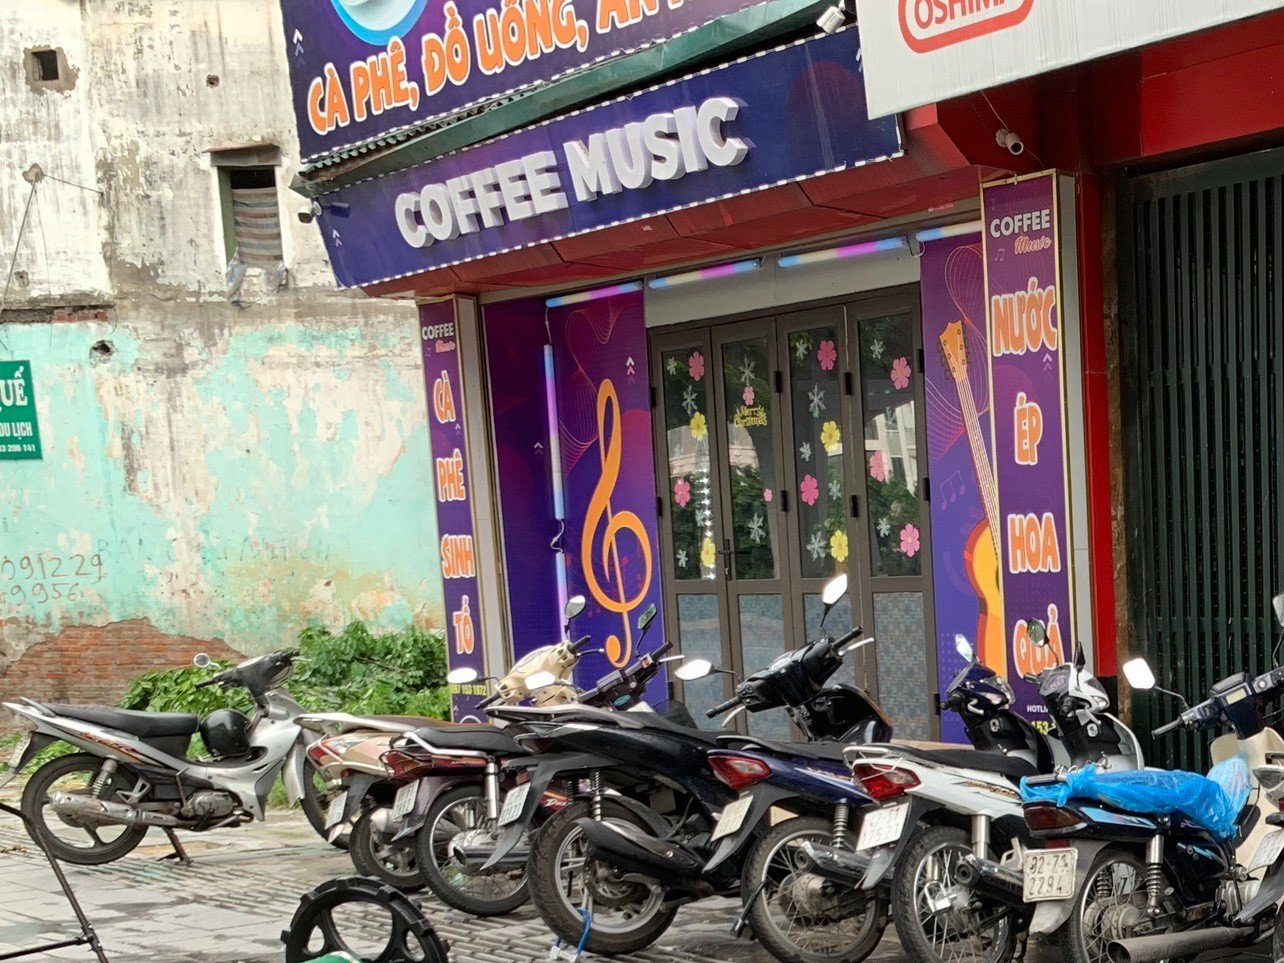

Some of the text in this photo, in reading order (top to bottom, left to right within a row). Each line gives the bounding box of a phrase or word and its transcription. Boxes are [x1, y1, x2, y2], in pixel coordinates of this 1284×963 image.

[306, 61, 351, 135] CÀ
[349, 35, 420, 121] PHÊ,
[422, 1, 471, 96] ĐỒ
[395, 97, 749, 248] COFFEE MUSIC
[989, 208, 1051, 238] COFFEE
[1014, 235, 1052, 254] Music
[421, 322, 456, 341] COFFEE
[991, 276, 1058, 357] NƯỚC
[0, 365, 28, 413] UẾ
[433, 369, 456, 424] CÀ
[12, 421, 33, 440] LỊCH
[436, 447, 467, 503] PHÊ
[441, 533, 476, 579] SINH
[1007, 512, 1062, 574] HOA
[1026, 705, 1049, 713] HOTLI
